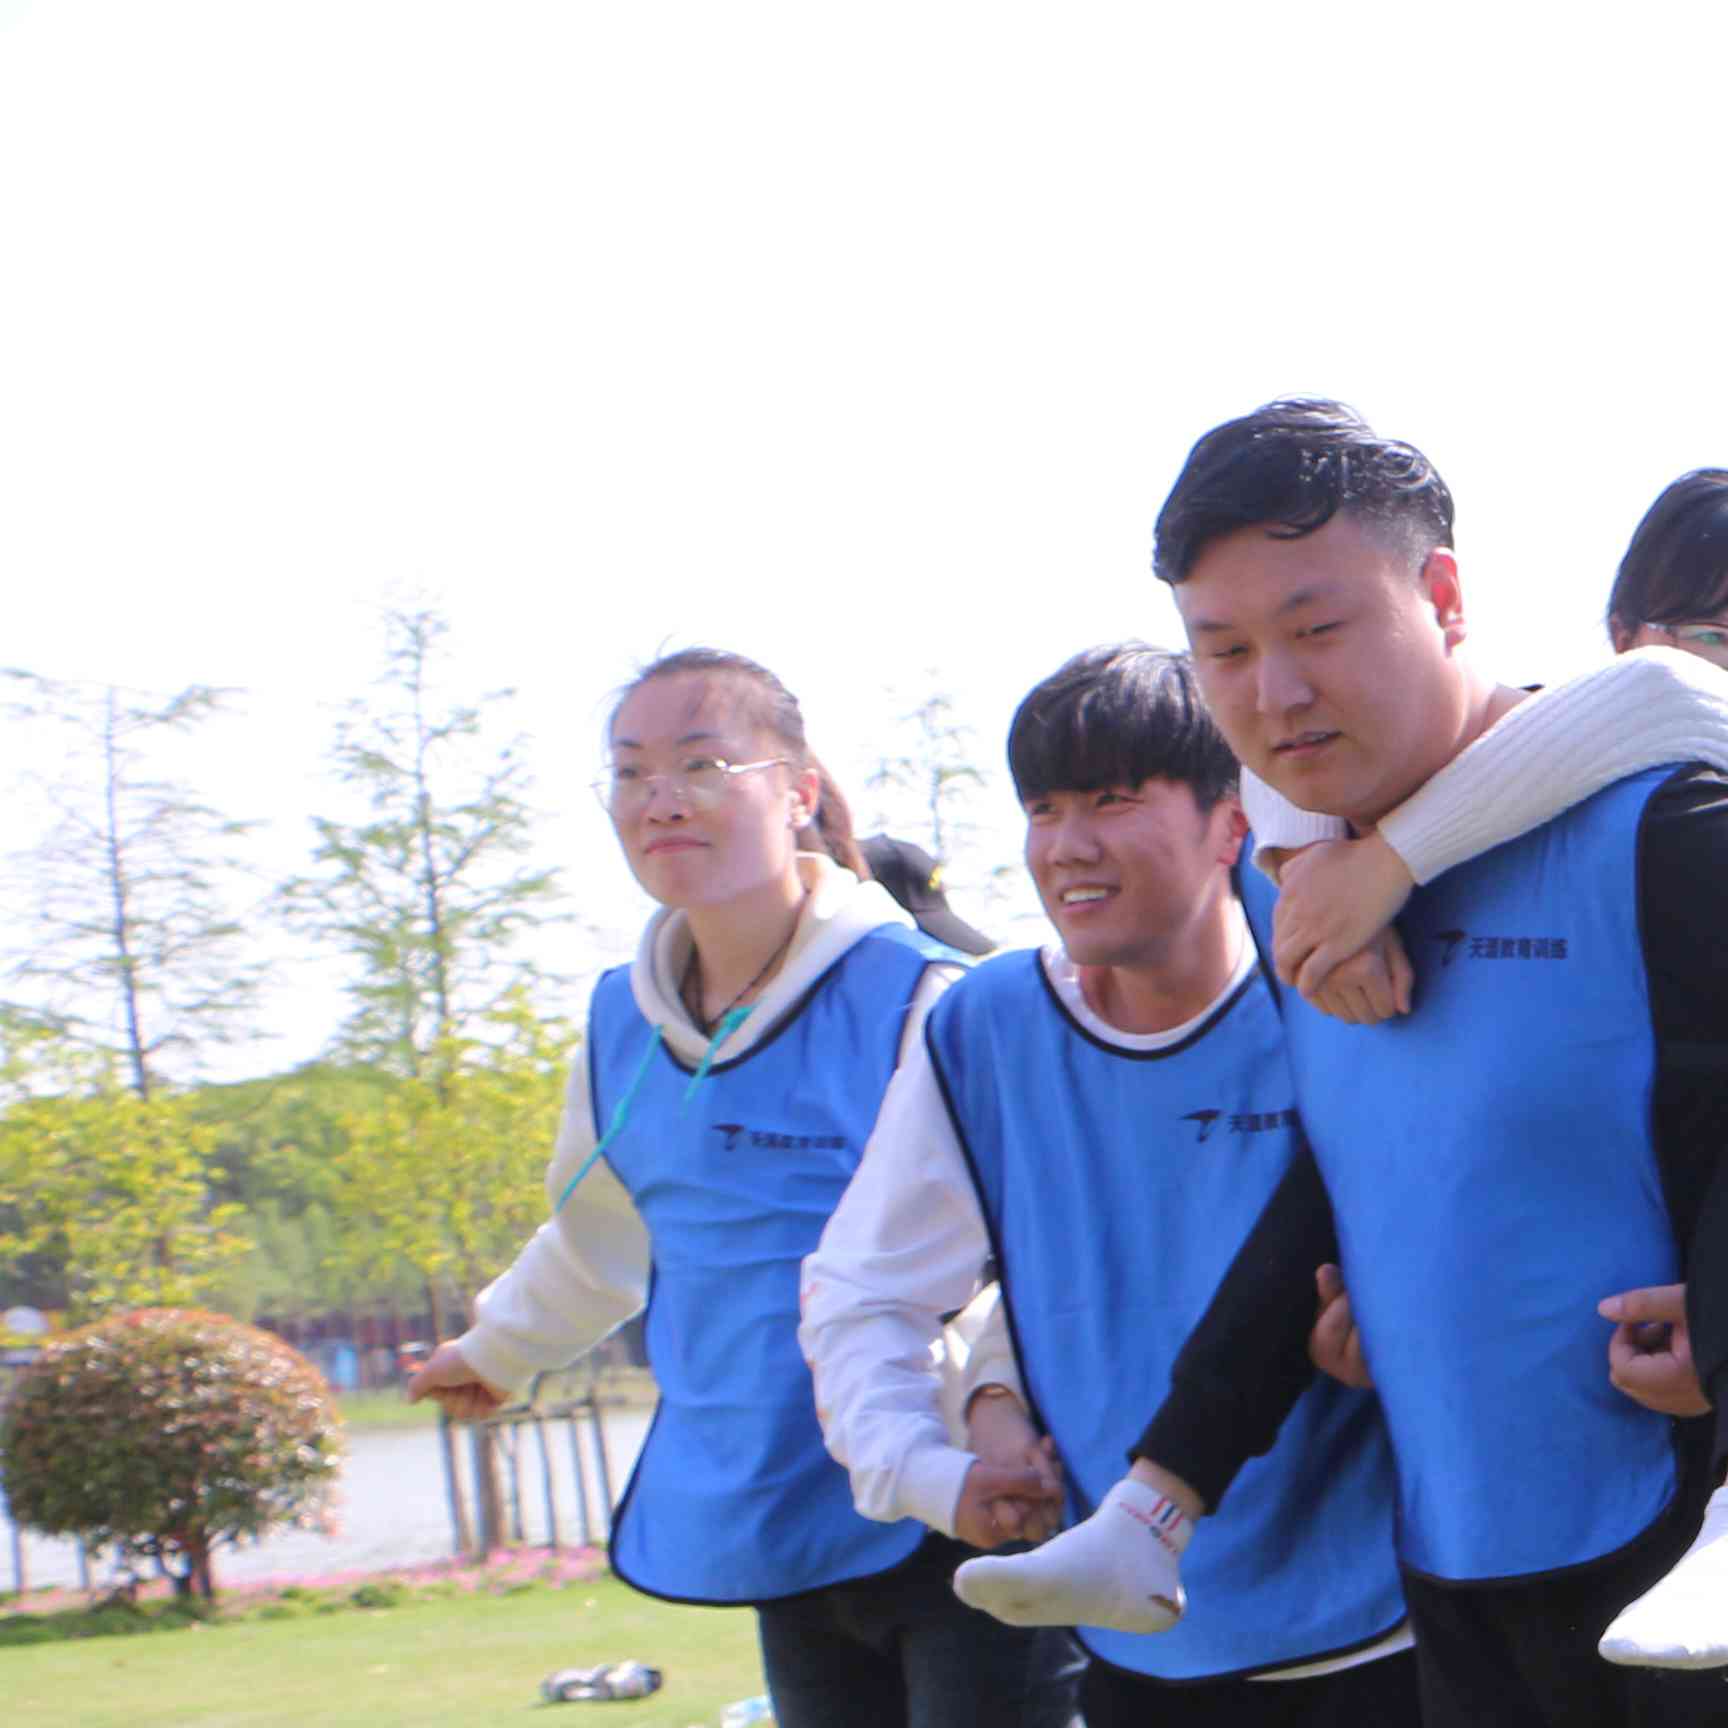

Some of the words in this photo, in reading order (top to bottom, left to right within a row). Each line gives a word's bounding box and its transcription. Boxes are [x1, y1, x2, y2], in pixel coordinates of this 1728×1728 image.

[1470, 937, 1569, 960] 天涯教育训练
